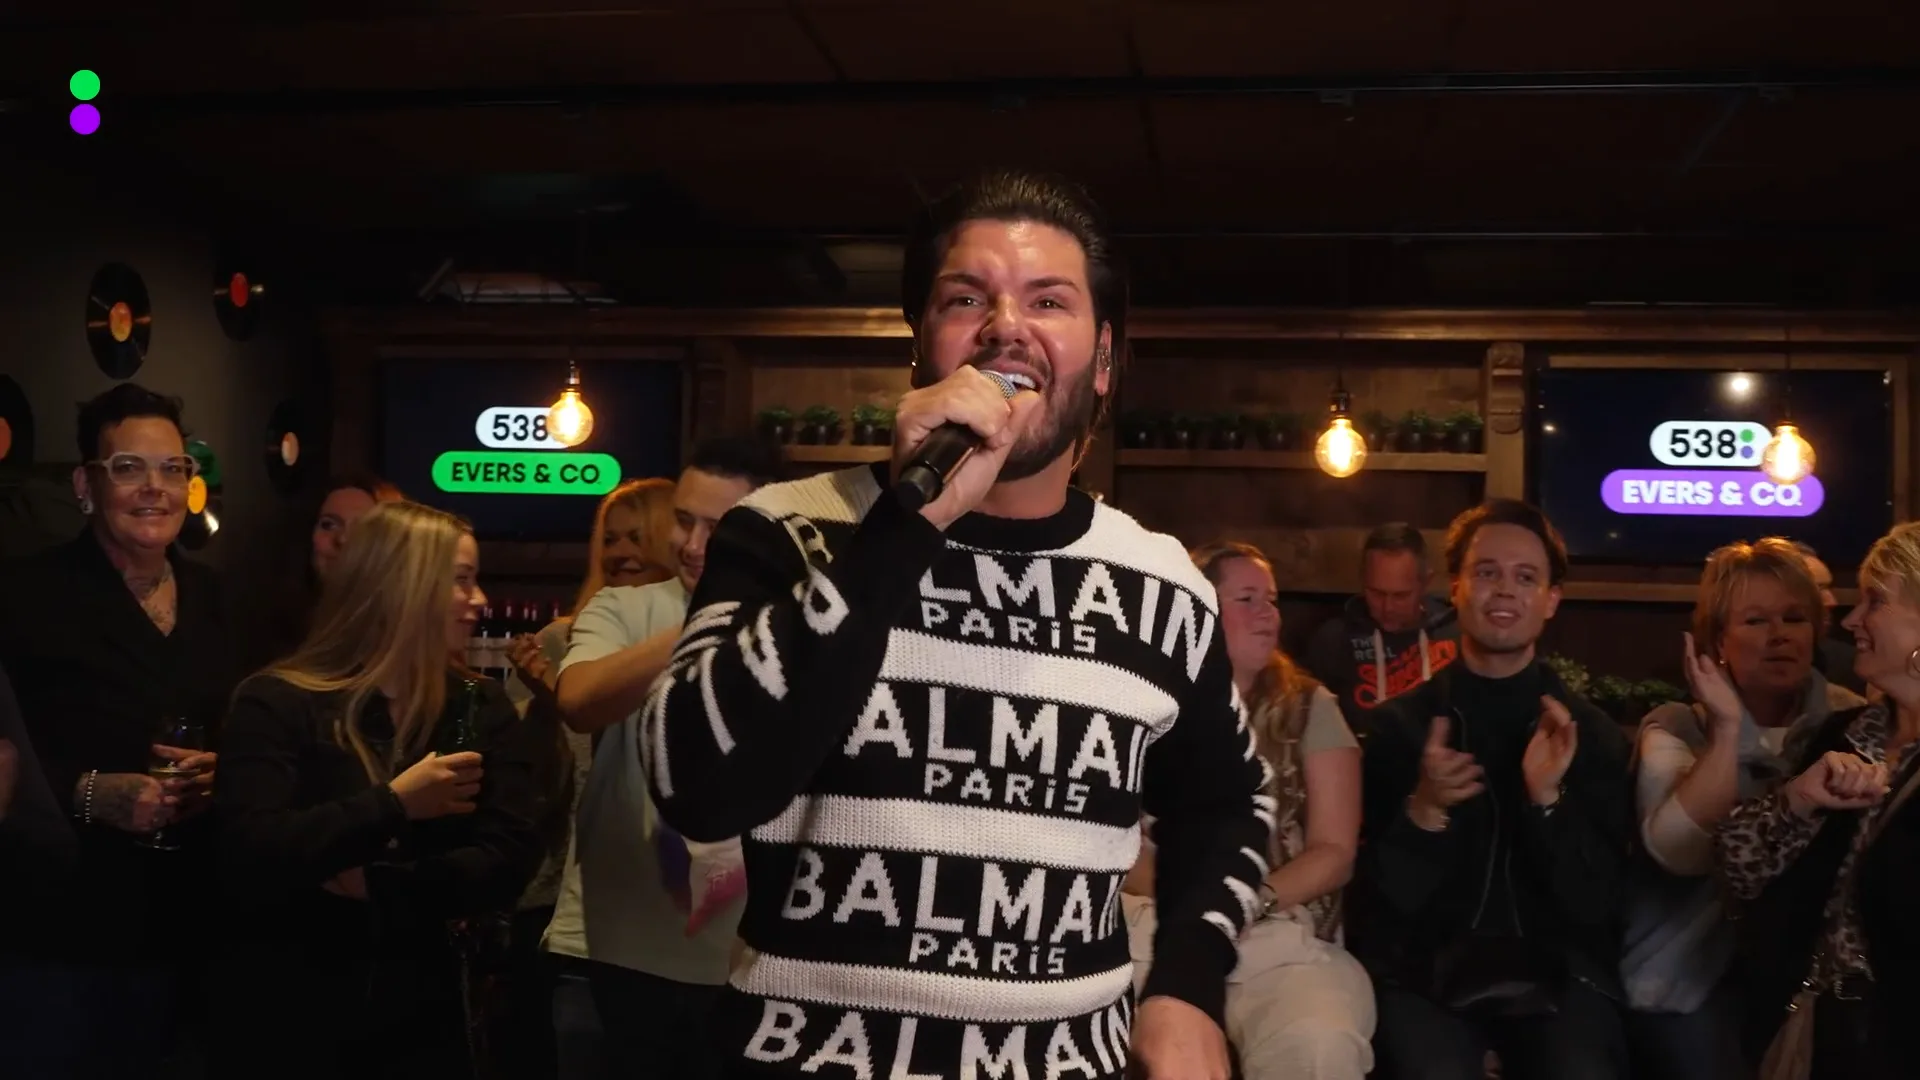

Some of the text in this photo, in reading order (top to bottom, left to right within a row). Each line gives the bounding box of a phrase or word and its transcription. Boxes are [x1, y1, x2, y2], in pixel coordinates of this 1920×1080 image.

[492, 413, 549, 442] 538
[1668, 427, 1738, 460] 538
[451, 461, 526, 483] EVERS
[533, 462, 552, 484] &
[1621, 478, 1715, 506] EVERS
[1718, 480, 1745, 506] &
[918, 552, 1218, 684] LMAIN
[1352, 644, 1398, 661] REL
[843, 681, 1150, 794] ALMAI
